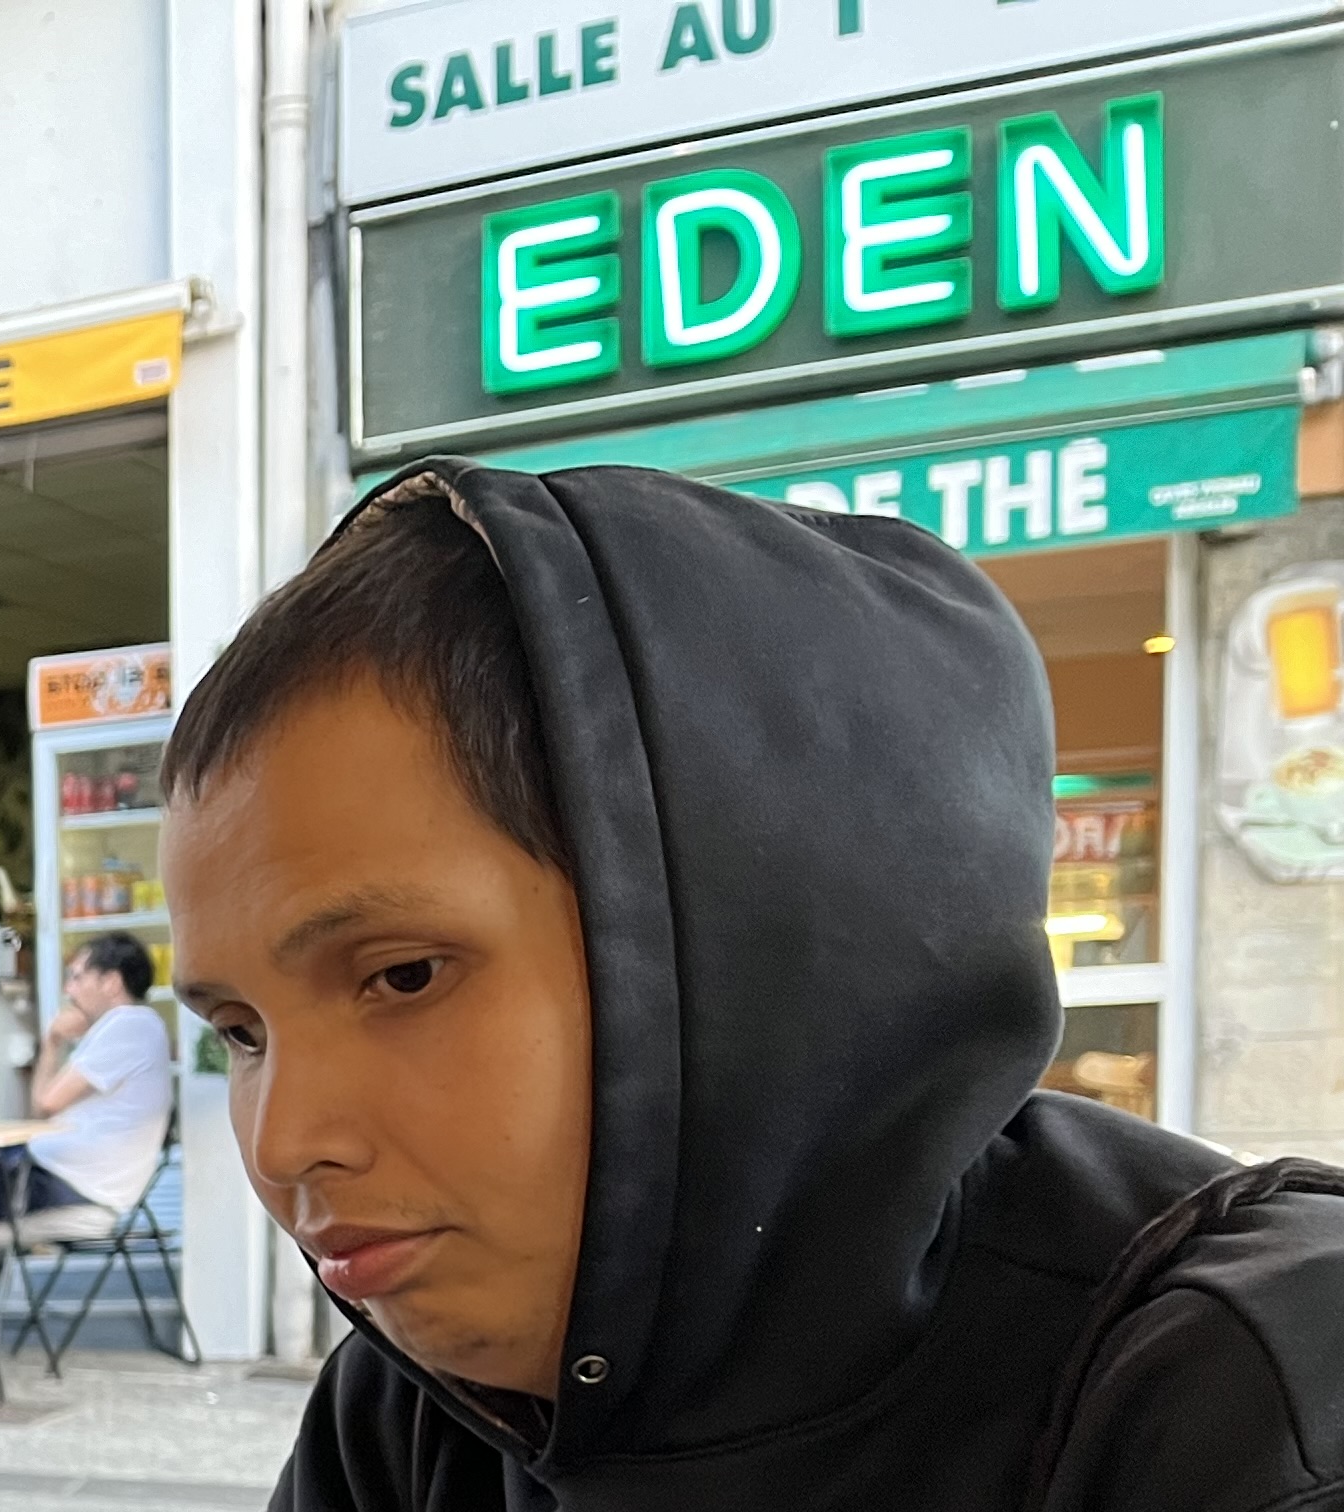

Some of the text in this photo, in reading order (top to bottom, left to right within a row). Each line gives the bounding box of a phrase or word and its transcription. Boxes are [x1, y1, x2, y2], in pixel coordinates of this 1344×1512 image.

[389, 20, 617, 128] SALLE
[660, 0, 773, 71] AU
[482, 90, 1164, 395] EDEN
